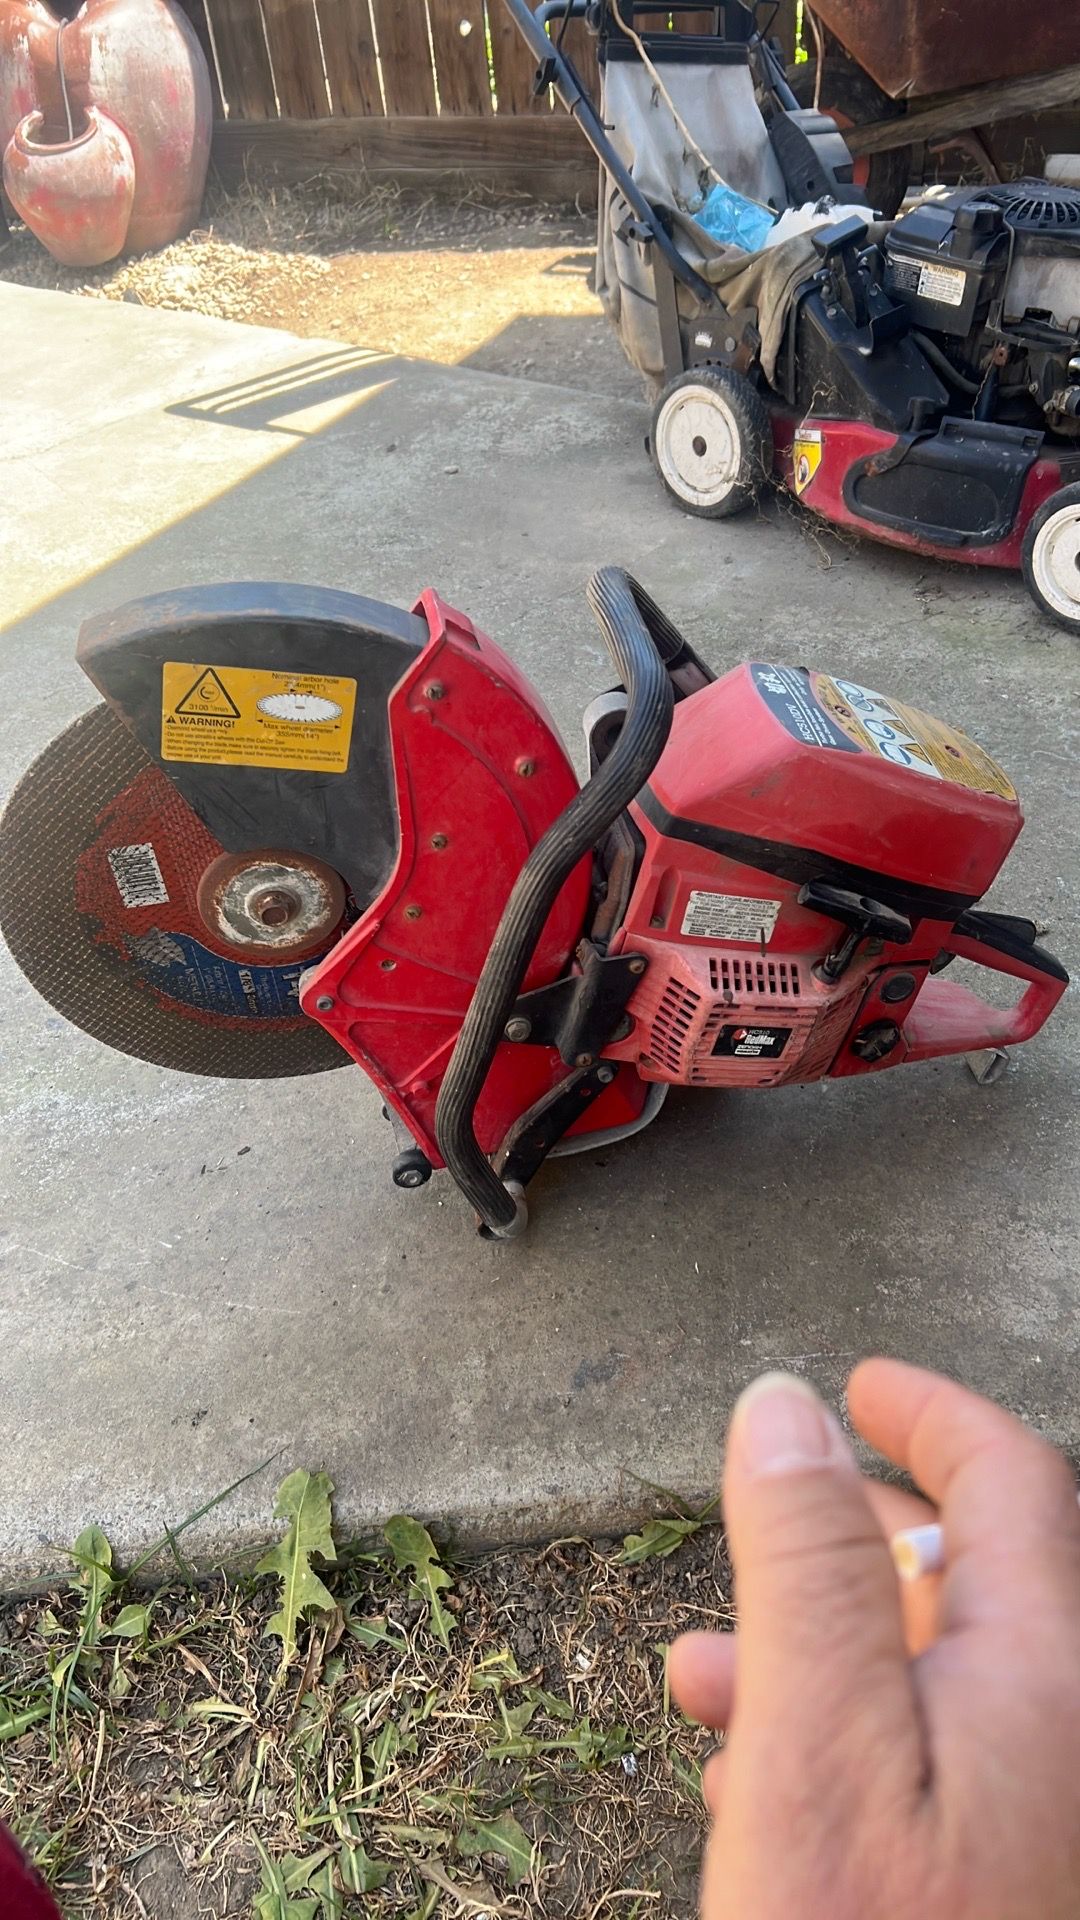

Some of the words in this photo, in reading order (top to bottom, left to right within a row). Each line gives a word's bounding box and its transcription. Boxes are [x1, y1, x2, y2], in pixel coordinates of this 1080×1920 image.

[324, 676, 339, 684] hole
[189, 703, 209, 711] 3100
[179, 716, 235, 728] WARNING!
[744, 1034, 776, 1045] RedMax
